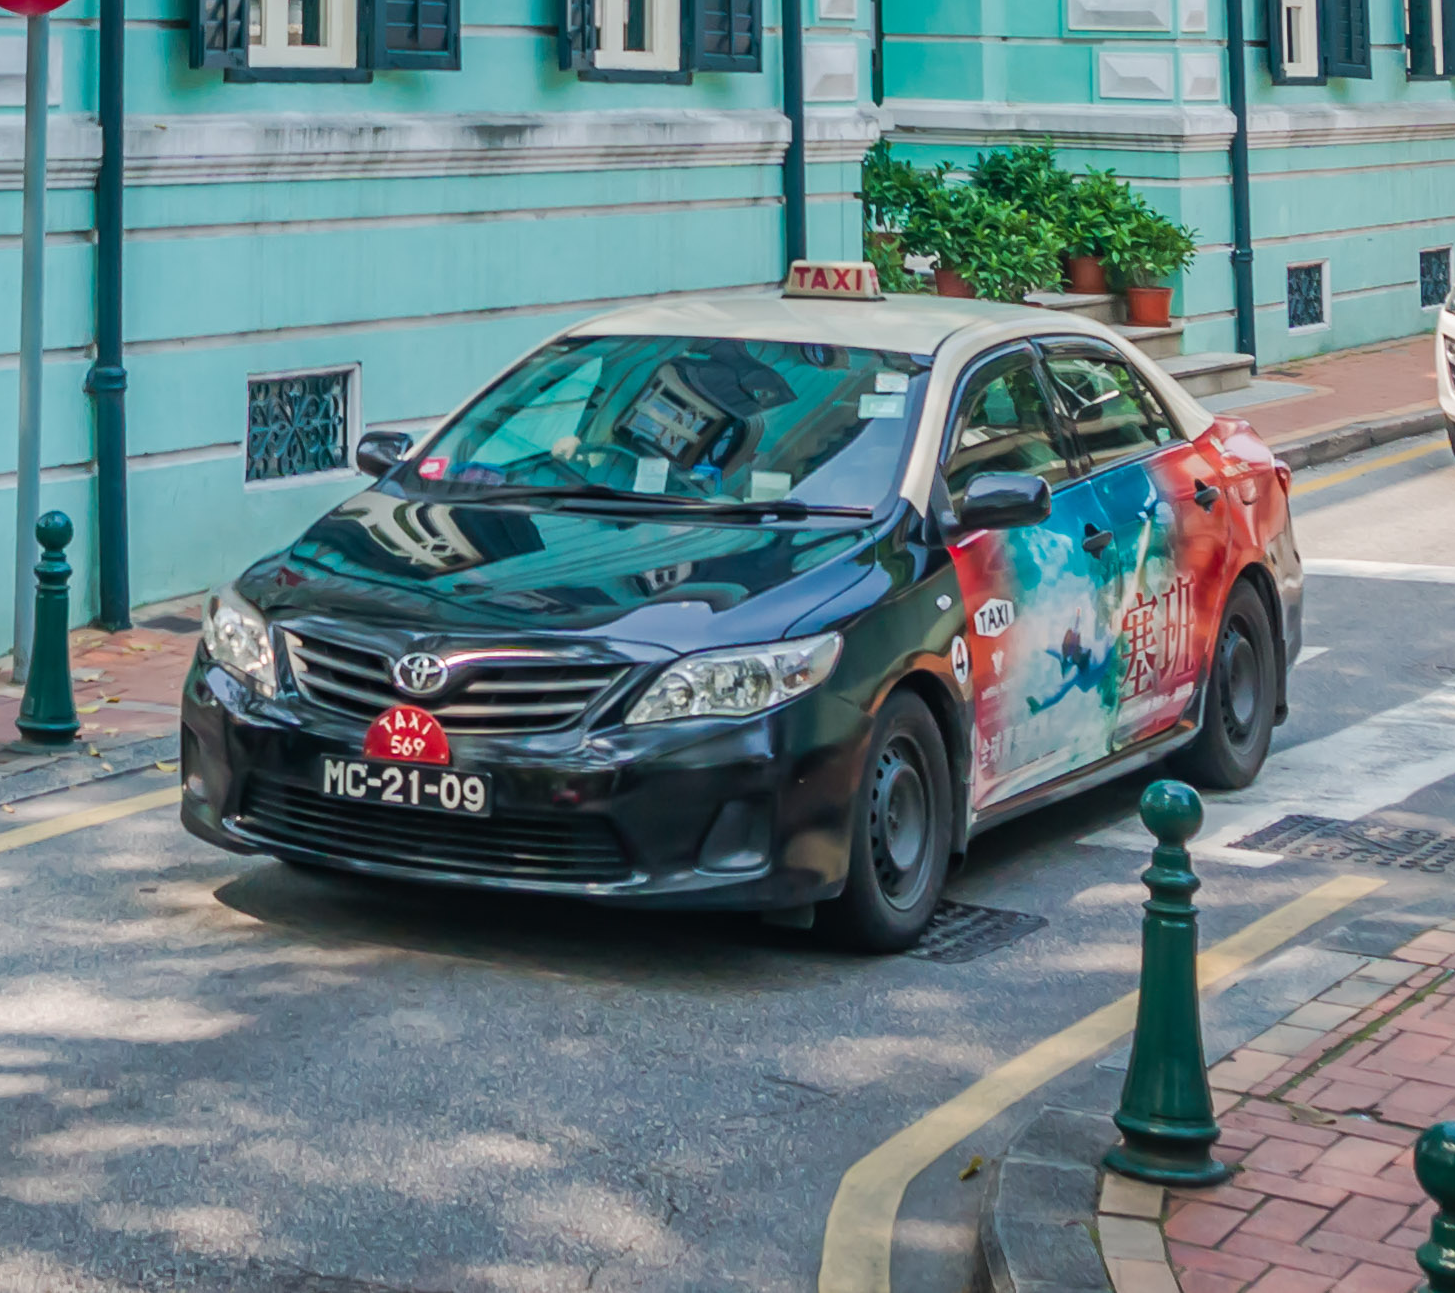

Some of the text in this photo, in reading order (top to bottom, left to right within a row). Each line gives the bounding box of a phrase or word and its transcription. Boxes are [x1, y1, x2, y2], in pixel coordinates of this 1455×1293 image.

[793, 266, 862, 291] TAXI
[978, 603, 1010, 634] TAXI
[1119, 575, 1196, 703] 塞班
[955, 642, 966, 676] 4
[378, 710, 433, 736] TAXI
[391, 735, 426, 757] 569
[323, 758, 485, 813] MC-21-09
